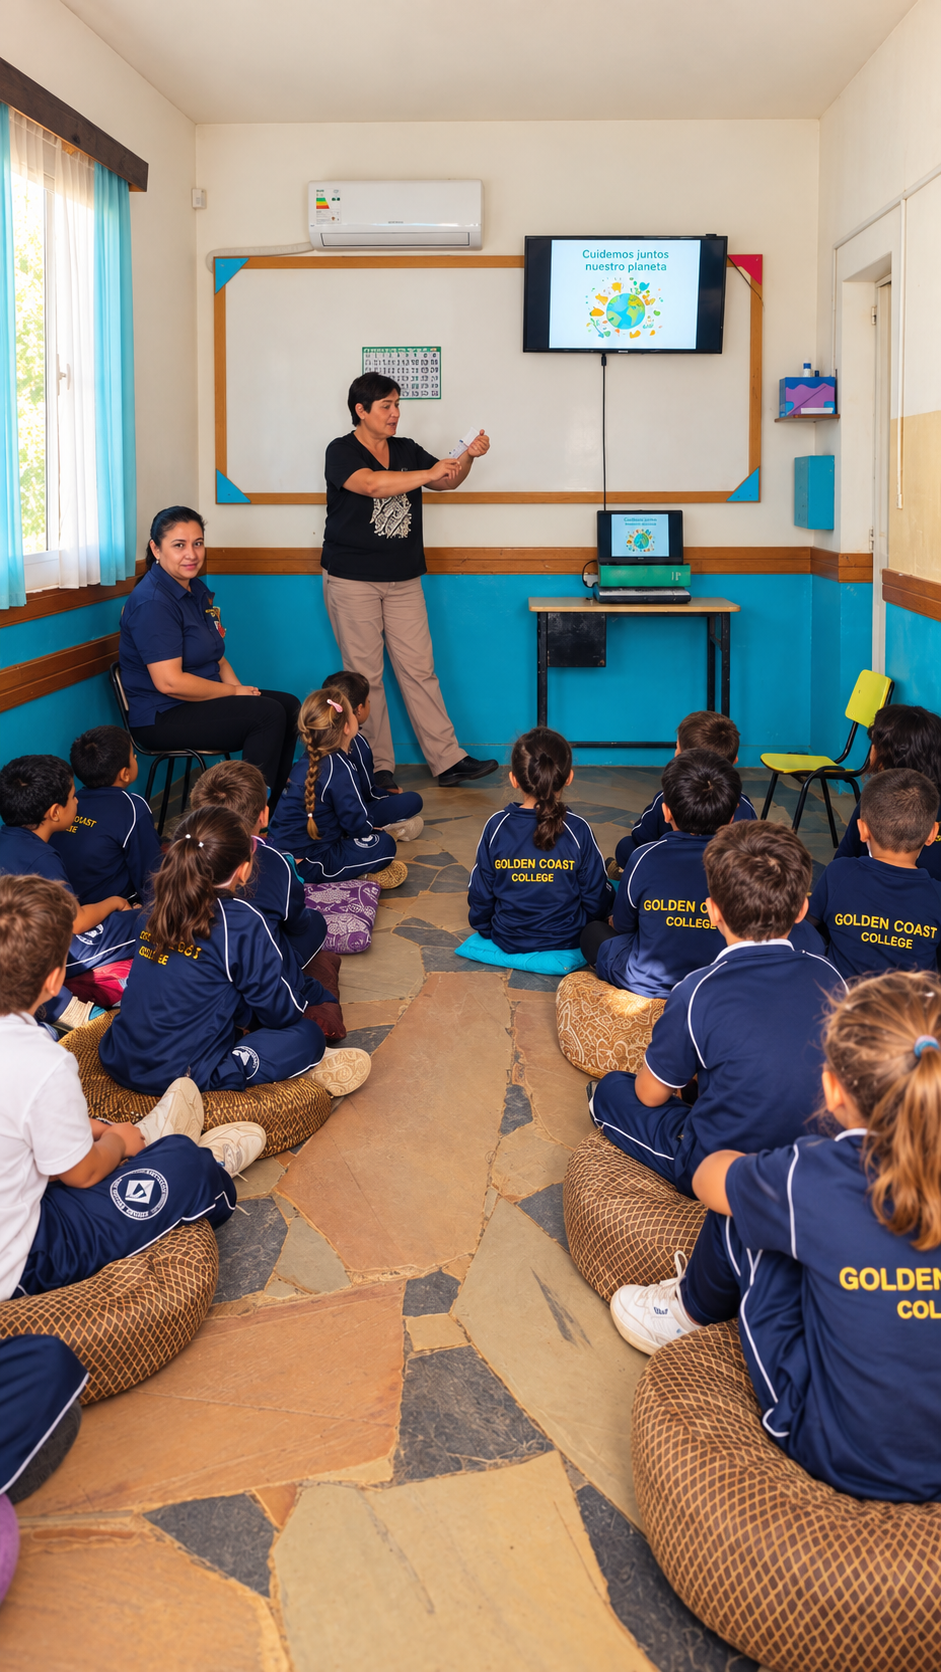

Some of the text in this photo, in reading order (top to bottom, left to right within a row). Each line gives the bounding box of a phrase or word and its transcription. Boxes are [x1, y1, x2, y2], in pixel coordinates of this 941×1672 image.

[582, 249, 669, 261] Cuidemos juntos
[585, 262, 667, 273] nuestro planeta
[494, 858, 575, 871] GOLDEN COAST
[511, 873, 554, 882] COLLEGE
[643, 899, 696, 913] GOLDEN
[834, 913, 938, 939] GOLDEN COAST
[860, 931, 914, 950] COLLEGE
